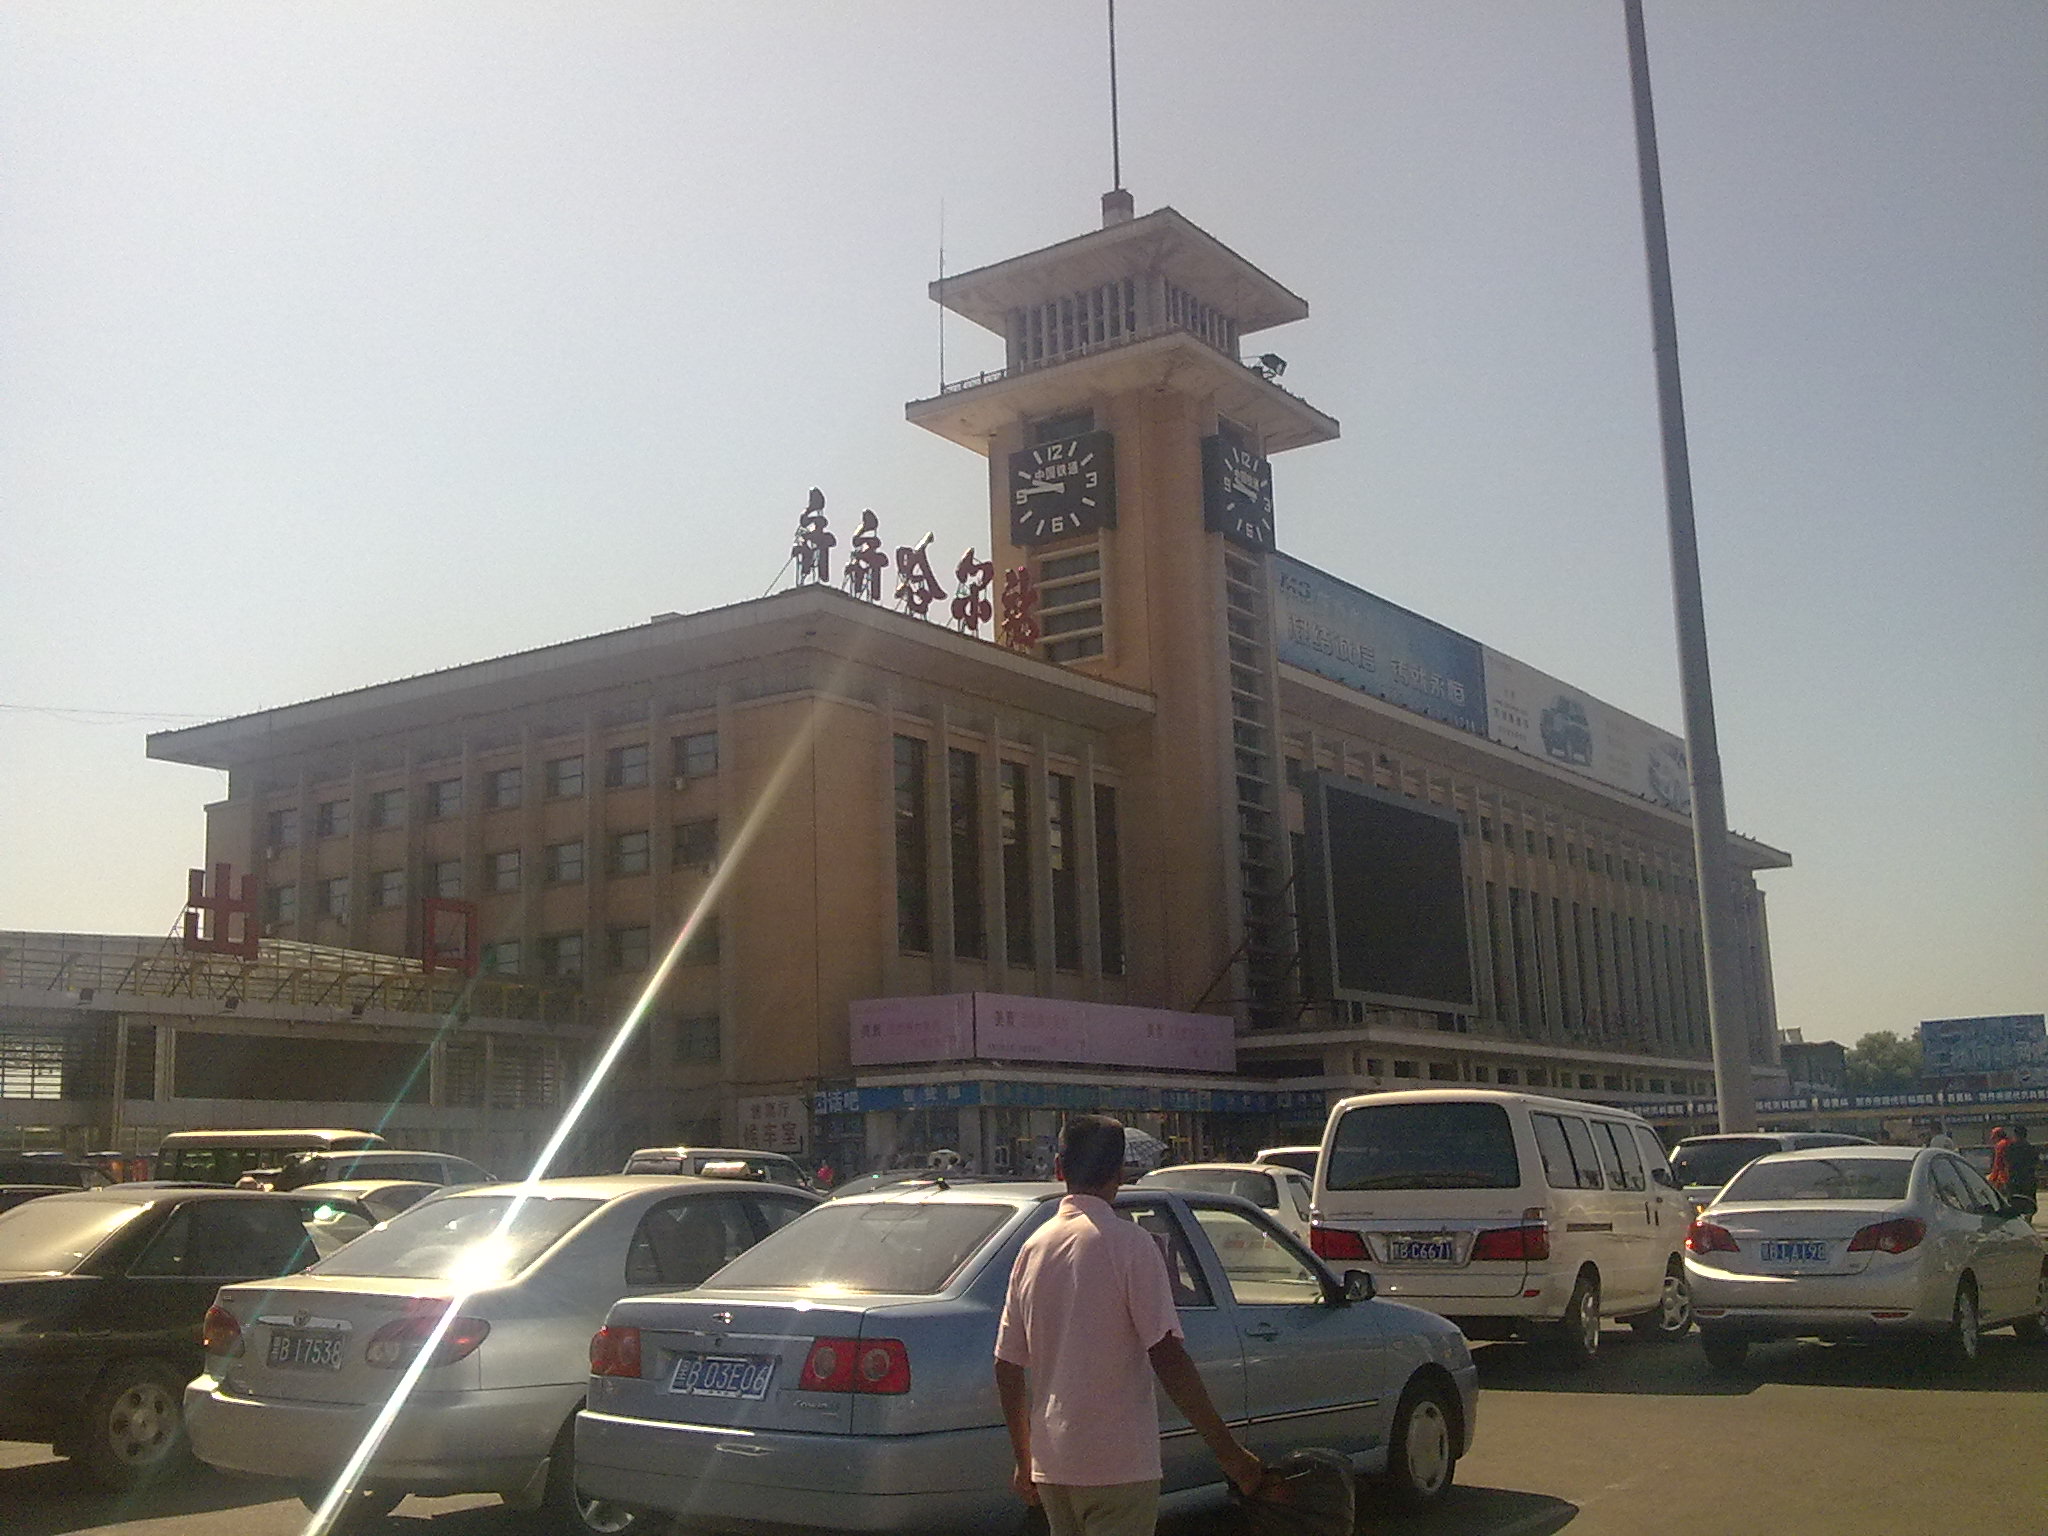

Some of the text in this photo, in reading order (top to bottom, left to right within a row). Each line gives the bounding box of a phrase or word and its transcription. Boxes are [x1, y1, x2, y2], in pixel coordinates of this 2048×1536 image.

[1047, 443, 1063, 461] 12
[1085, 471, 1098, 488] 3
[1224, 476, 1232, 493] 9
[1052, 516, 1064, 533] 6
